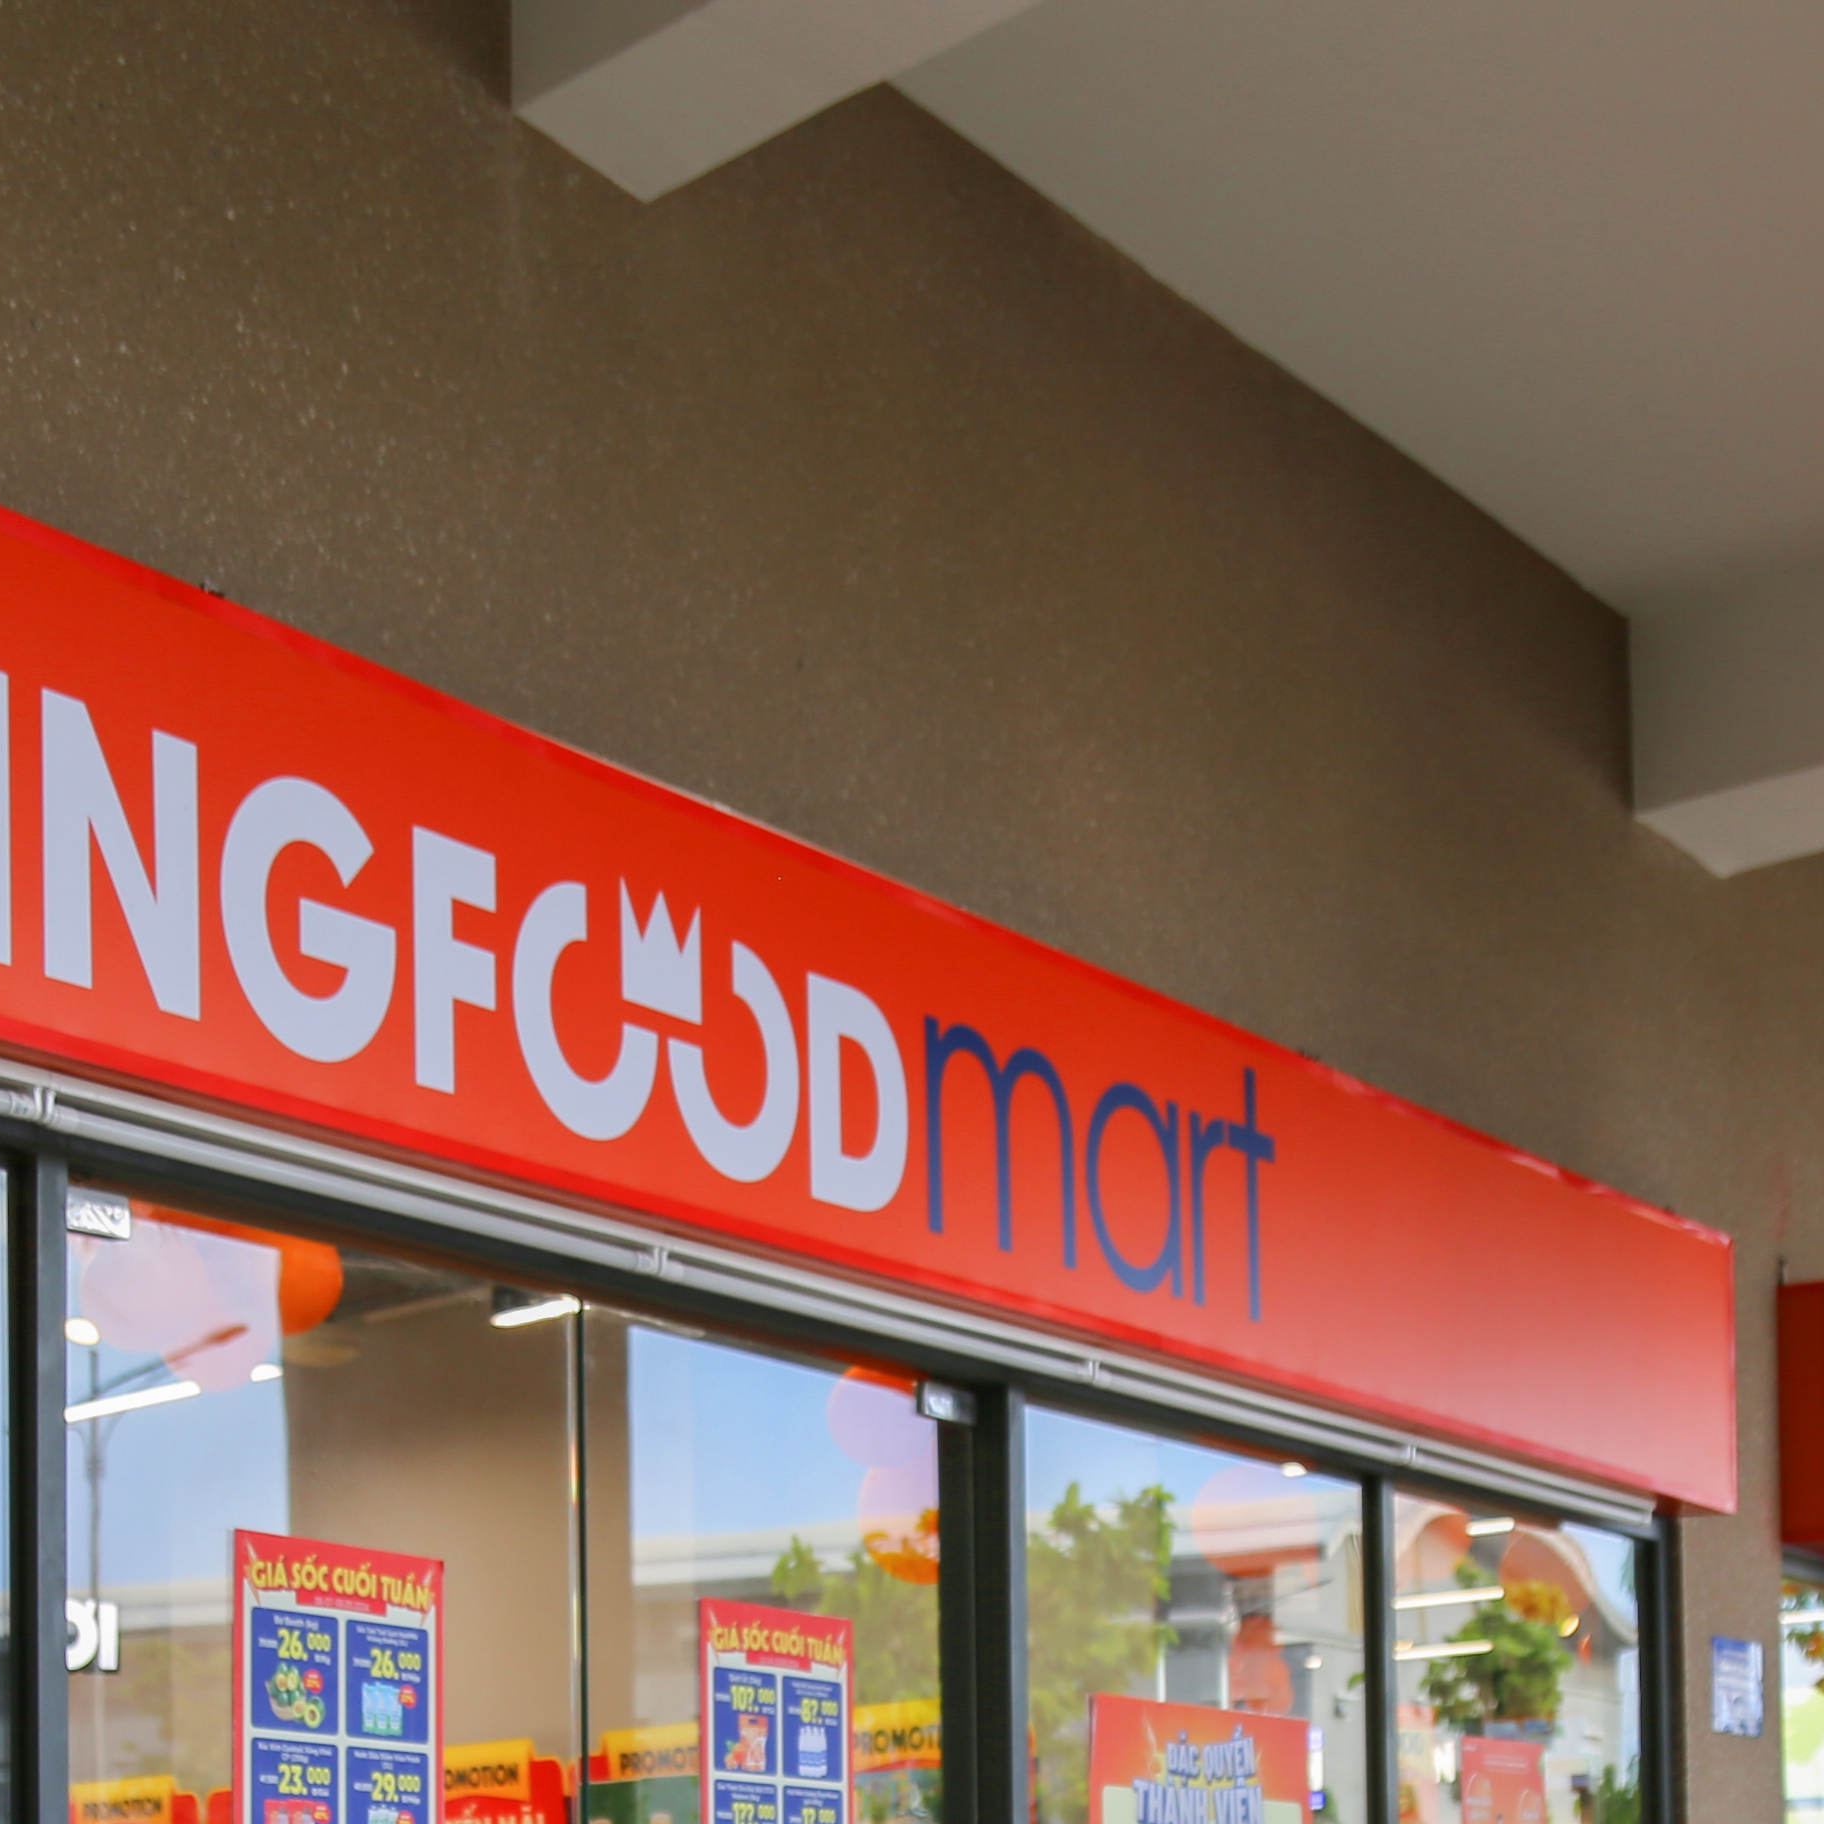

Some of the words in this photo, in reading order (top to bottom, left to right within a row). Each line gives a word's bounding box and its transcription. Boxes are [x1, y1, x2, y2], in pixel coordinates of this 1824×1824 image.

[252, 1554, 289, 1589] GIÁ
[291, 1554, 329, 1592] SỐC
[332, 1563, 377, 1599] CUỐI
